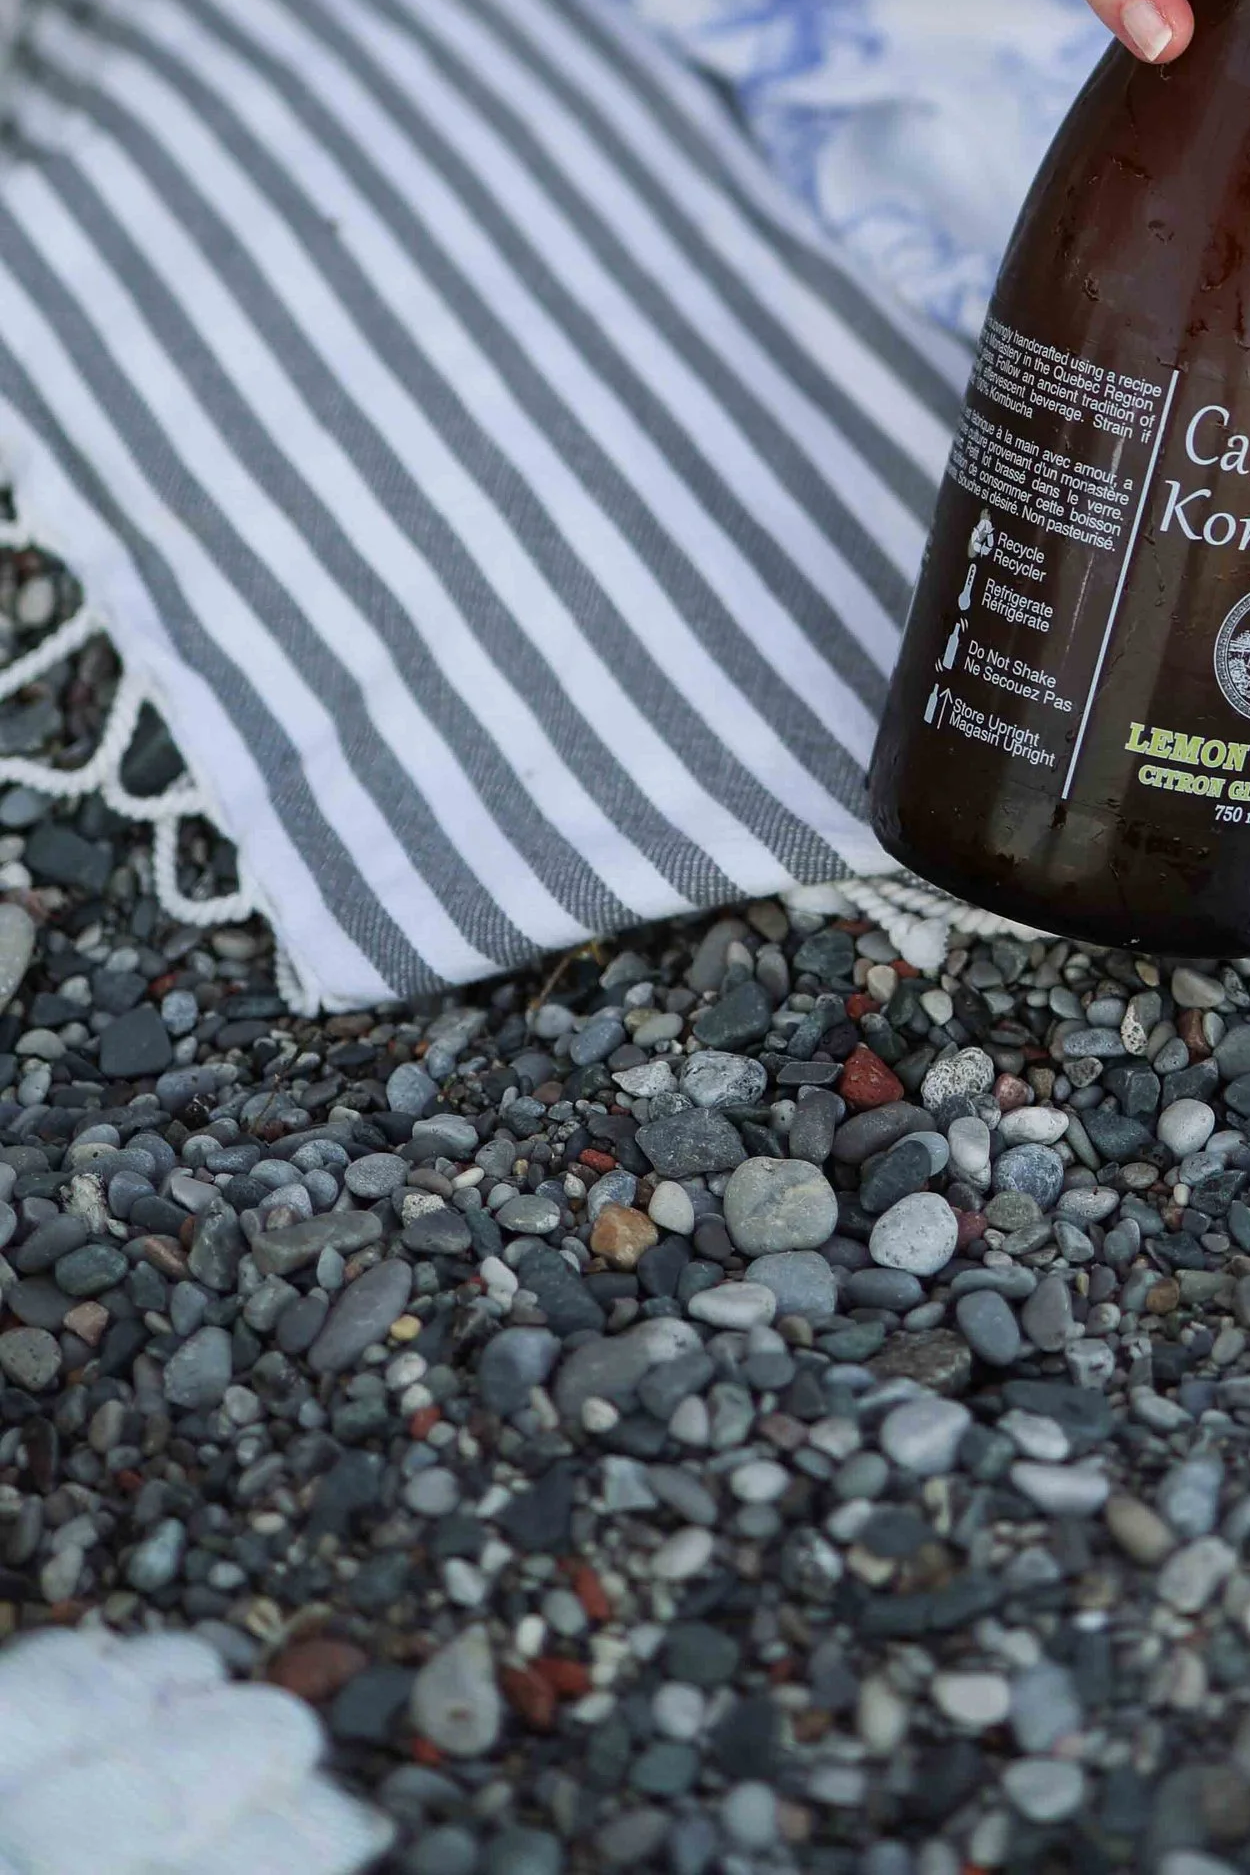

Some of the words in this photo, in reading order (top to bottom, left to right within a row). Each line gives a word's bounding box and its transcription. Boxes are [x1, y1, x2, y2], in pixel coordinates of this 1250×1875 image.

[995, 354, 1021, 378] Follow
[1022, 372, 1034, 385] an
[1037, 378, 1079, 404] ancient
[1082, 393, 1135, 423] tradition
[1139, 415, 1156, 428] of
[1013, 330, 1070, 365] handcrafted
[1070, 358, 1104, 382] using
[1106, 371, 1115, 383] a
[1119, 375, 1162, 397] recipe
[1022, 352, 1032, 367] in
[1033, 358, 1050, 375] the
[1053, 366, 1100, 394] Quebec
[1104, 384, 1154, 411] Region
[989, 386, 1034, 419] Kombucha
[1030, 389, 1084, 422] beverage.
[1093, 414, 1133, 439] Strain
[1141, 429, 1152, 444] if
[981, 451, 992, 468] lot
[994, 459, 1026, 484] brassé
[1031, 478, 1060, 499] dans
[1067, 489, 1079, 505] le
[1087, 499, 1124, 521] verre.
[987, 441, 1033, 471] provenant
[1033, 462, 1058, 481] d'un
[1060, 473, 1130, 505] monastère
[1004, 429, 1013, 444] la
[1015, 437, 1040, 457] main
[1042, 449, 1071, 469] avec
[1074, 462, 1118, 488] amour,
[1123, 479, 1134, 491] a
[968, 462, 978, 477] de
[979, 470, 1033, 503] consommer
[1035, 497, 1065, 517] cette
[1069, 507, 1122, 537] boisson
[980, 487, 991, 501] si
[1021, 505, 1046, 527] Non
[1046, 518, 1116, 552] pasteurisé.
[993, 548, 1047, 582] Recycler
[998, 531, 1045, 564] Recycle
[981, 592, 1050, 632] Réfrigérate
[985, 578, 1054, 618] Refrigerate
[964, 656, 981, 676] Ne
[982, 666, 1040, 701] Secouez
[1043, 691, 1073, 712] Pas
[968, 640, 985, 659] Do
[986, 649, 1010, 671] Not
[1012, 660, 1057, 688] Shake
[949, 711, 1000, 746] Magasin
[1003, 736, 1056, 767] Upright
[953, 698, 985, 724] Store
[988, 714, 1040, 747] Upright
[1124, 721, 1250, 772] LEMON
[1138, 764, 1226, 798] CITRON
[1214, 804, 1243, 823] 750
